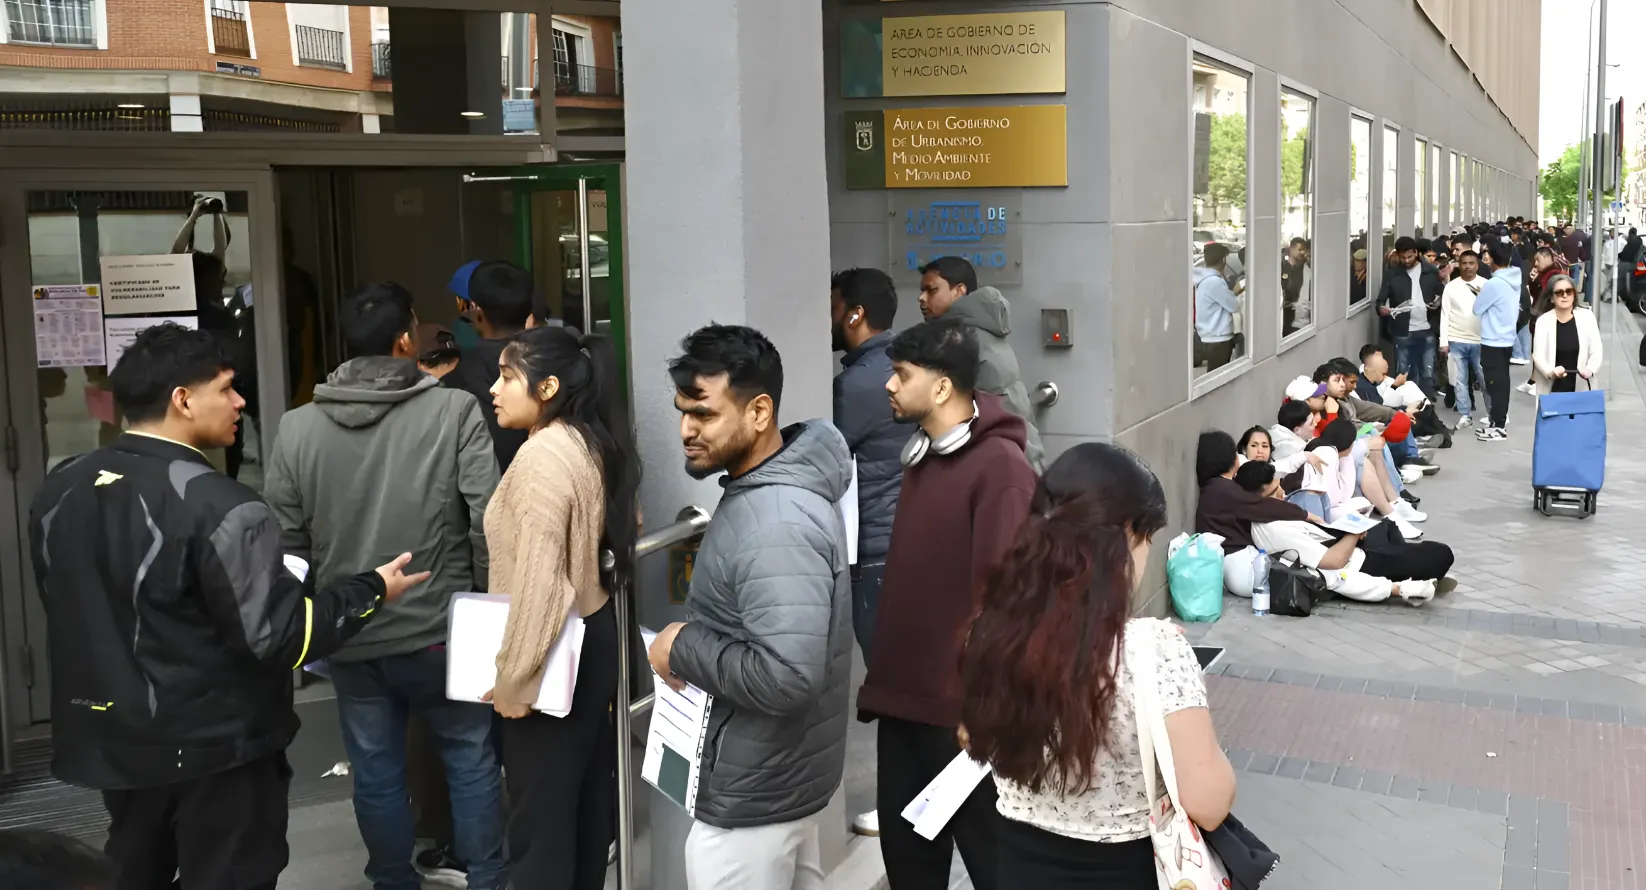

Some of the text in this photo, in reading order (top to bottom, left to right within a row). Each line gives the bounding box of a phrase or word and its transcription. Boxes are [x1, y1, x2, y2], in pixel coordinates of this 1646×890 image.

[927, 27, 943, 39] DE
[946, 24, 1014, 38] GOBIERNO
[1018, 23, 1035, 36] DE
[892, 64, 968, 78] Y HACIENDA
[945, 116, 1010, 130] GOBIERNO
[892, 138, 907, 148] DE
[893, 151, 991, 164] MEDIO AMBIENTE
[894, 168, 971, 181] Y MOVILIDAD
[987, 207, 1006, 220] DE
